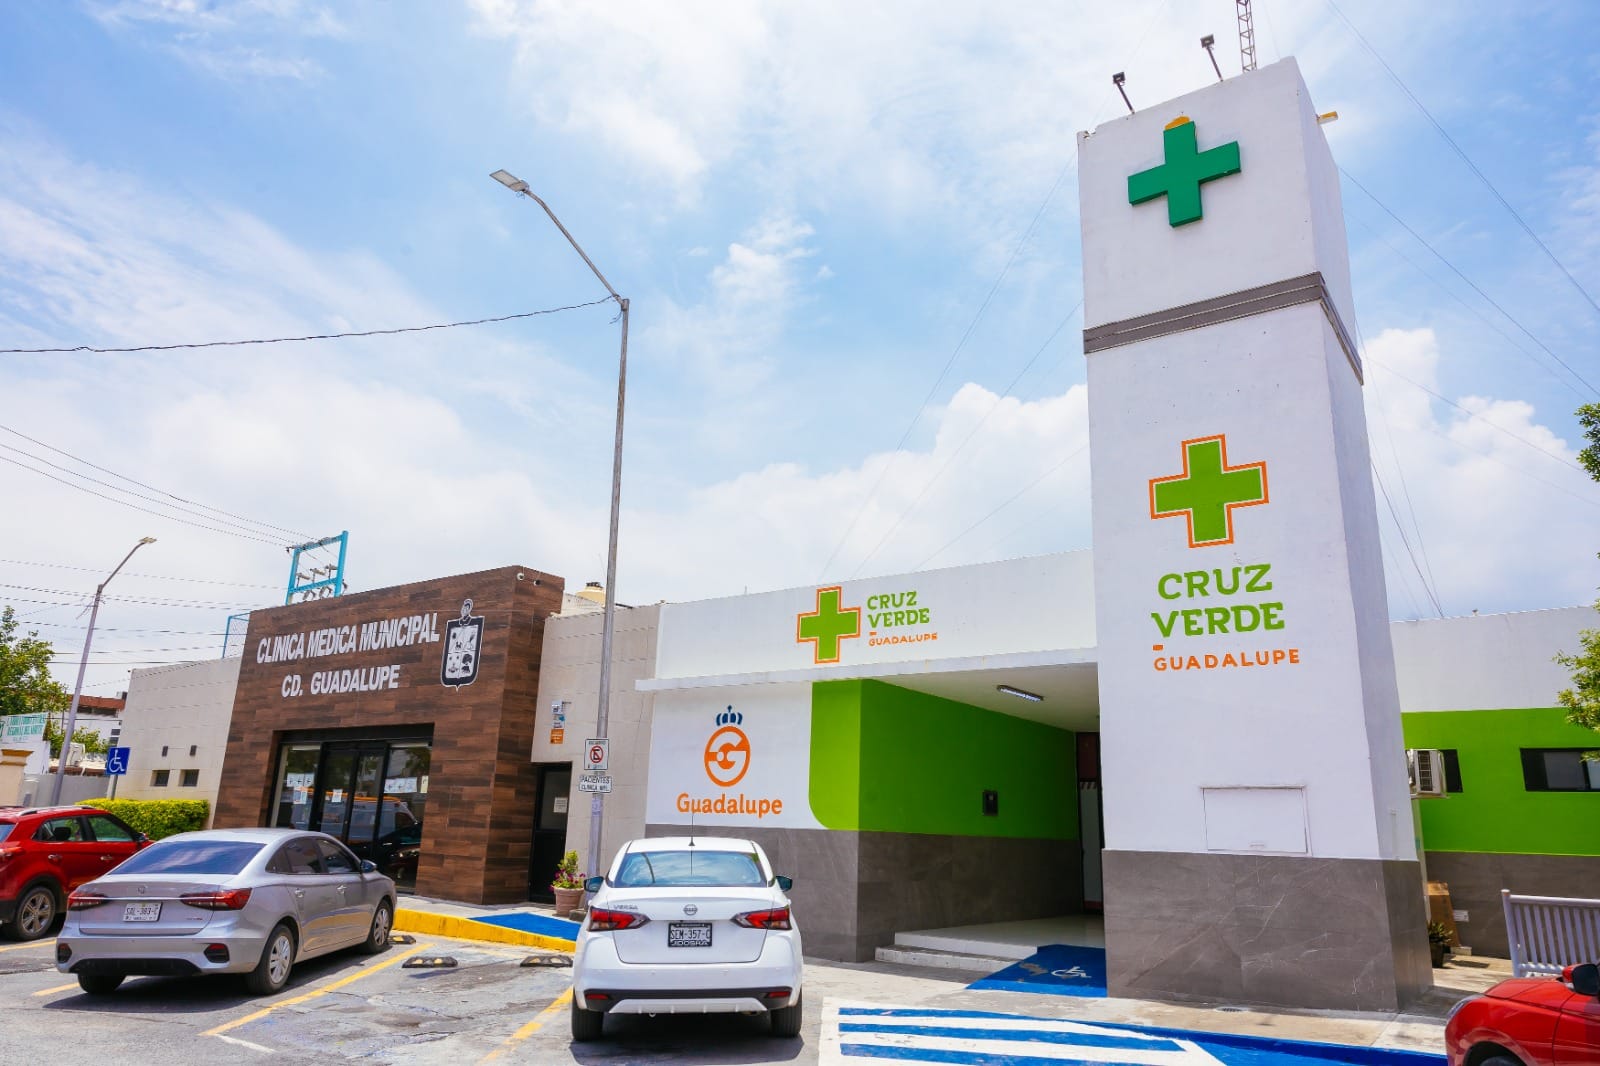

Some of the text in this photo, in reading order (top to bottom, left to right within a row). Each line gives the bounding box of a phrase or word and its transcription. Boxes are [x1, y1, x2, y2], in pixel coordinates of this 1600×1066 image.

[1157, 563, 1273, 600] CRUZ
[866, 590, 918, 611] CRUZ
[867, 607, 931, 629] VERDE
[1150, 601, 1285, 638] VERDE
[256, 612, 440, 664] CLINICA MEDICA MUNICIPAL
[868, 632, 938, 647] GUADALUPE
[1153, 648, 1301, 672] GUADALUPE
[281, 664, 401, 698] CD. GUADALUPE
[676, 792, 783, 819] Guadalupe
